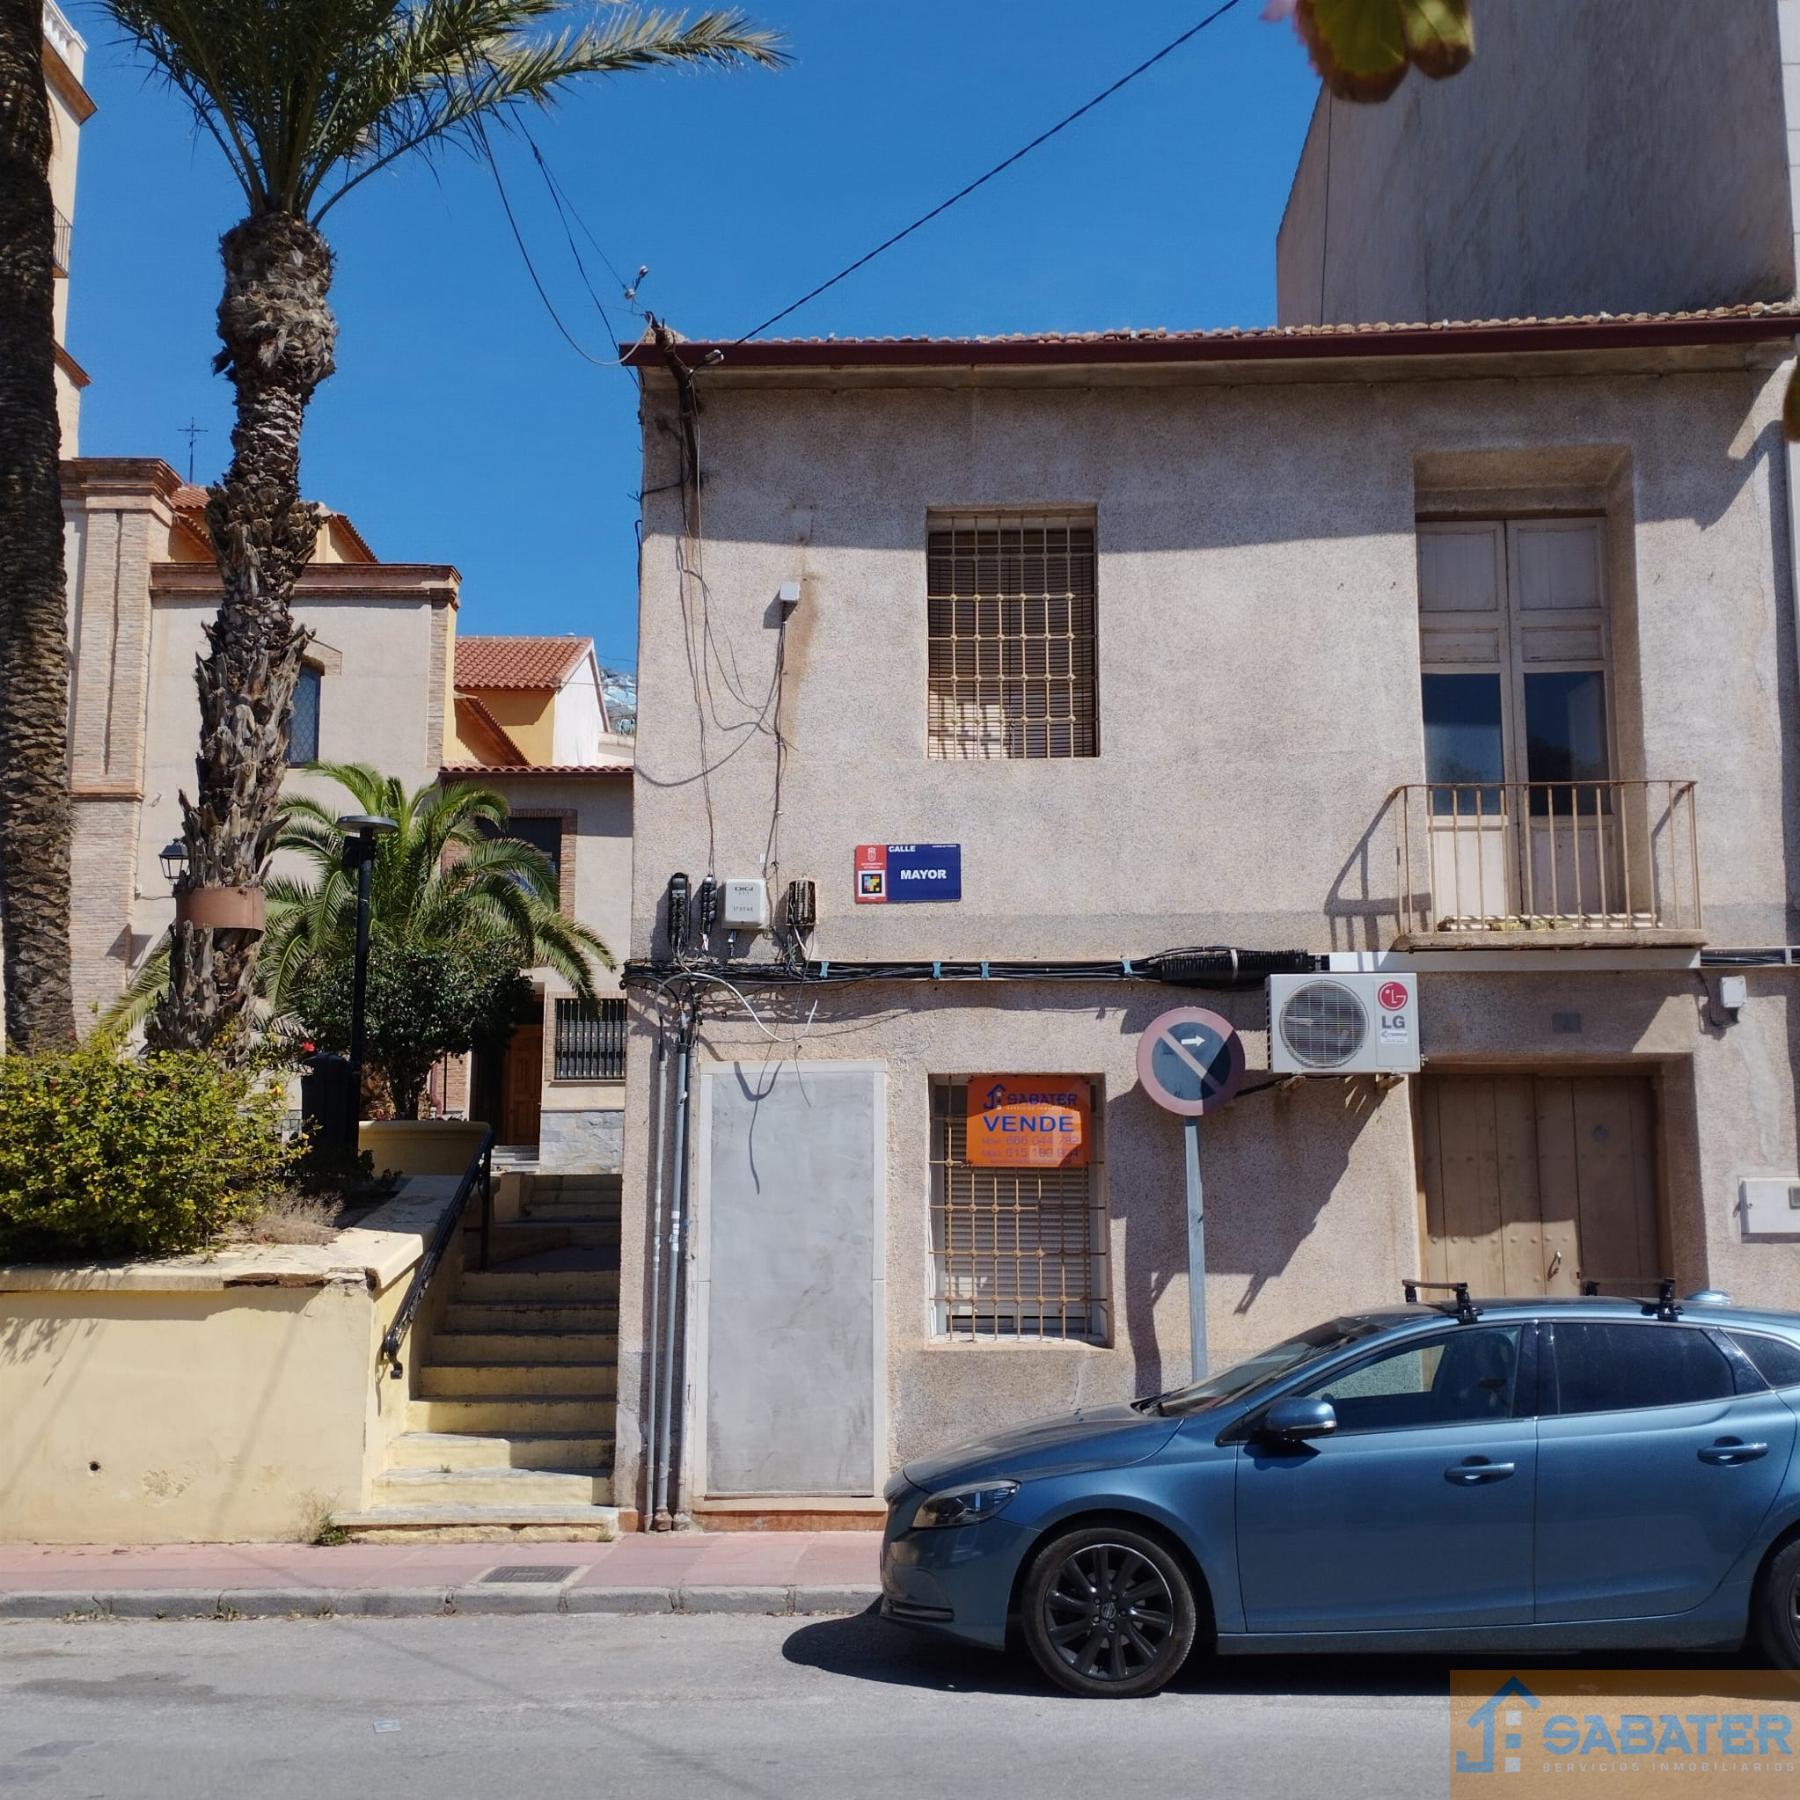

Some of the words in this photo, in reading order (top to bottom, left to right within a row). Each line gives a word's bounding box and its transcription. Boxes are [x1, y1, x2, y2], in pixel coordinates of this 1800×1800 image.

[888, 845, 916, 853] CALLE
[900, 869, 947, 880] MAYOR
[1381, 1015, 1406, 1029] LG
[1007, 1093, 1078, 1106] SABATER
[983, 1116, 1074, 1132] VENDE
